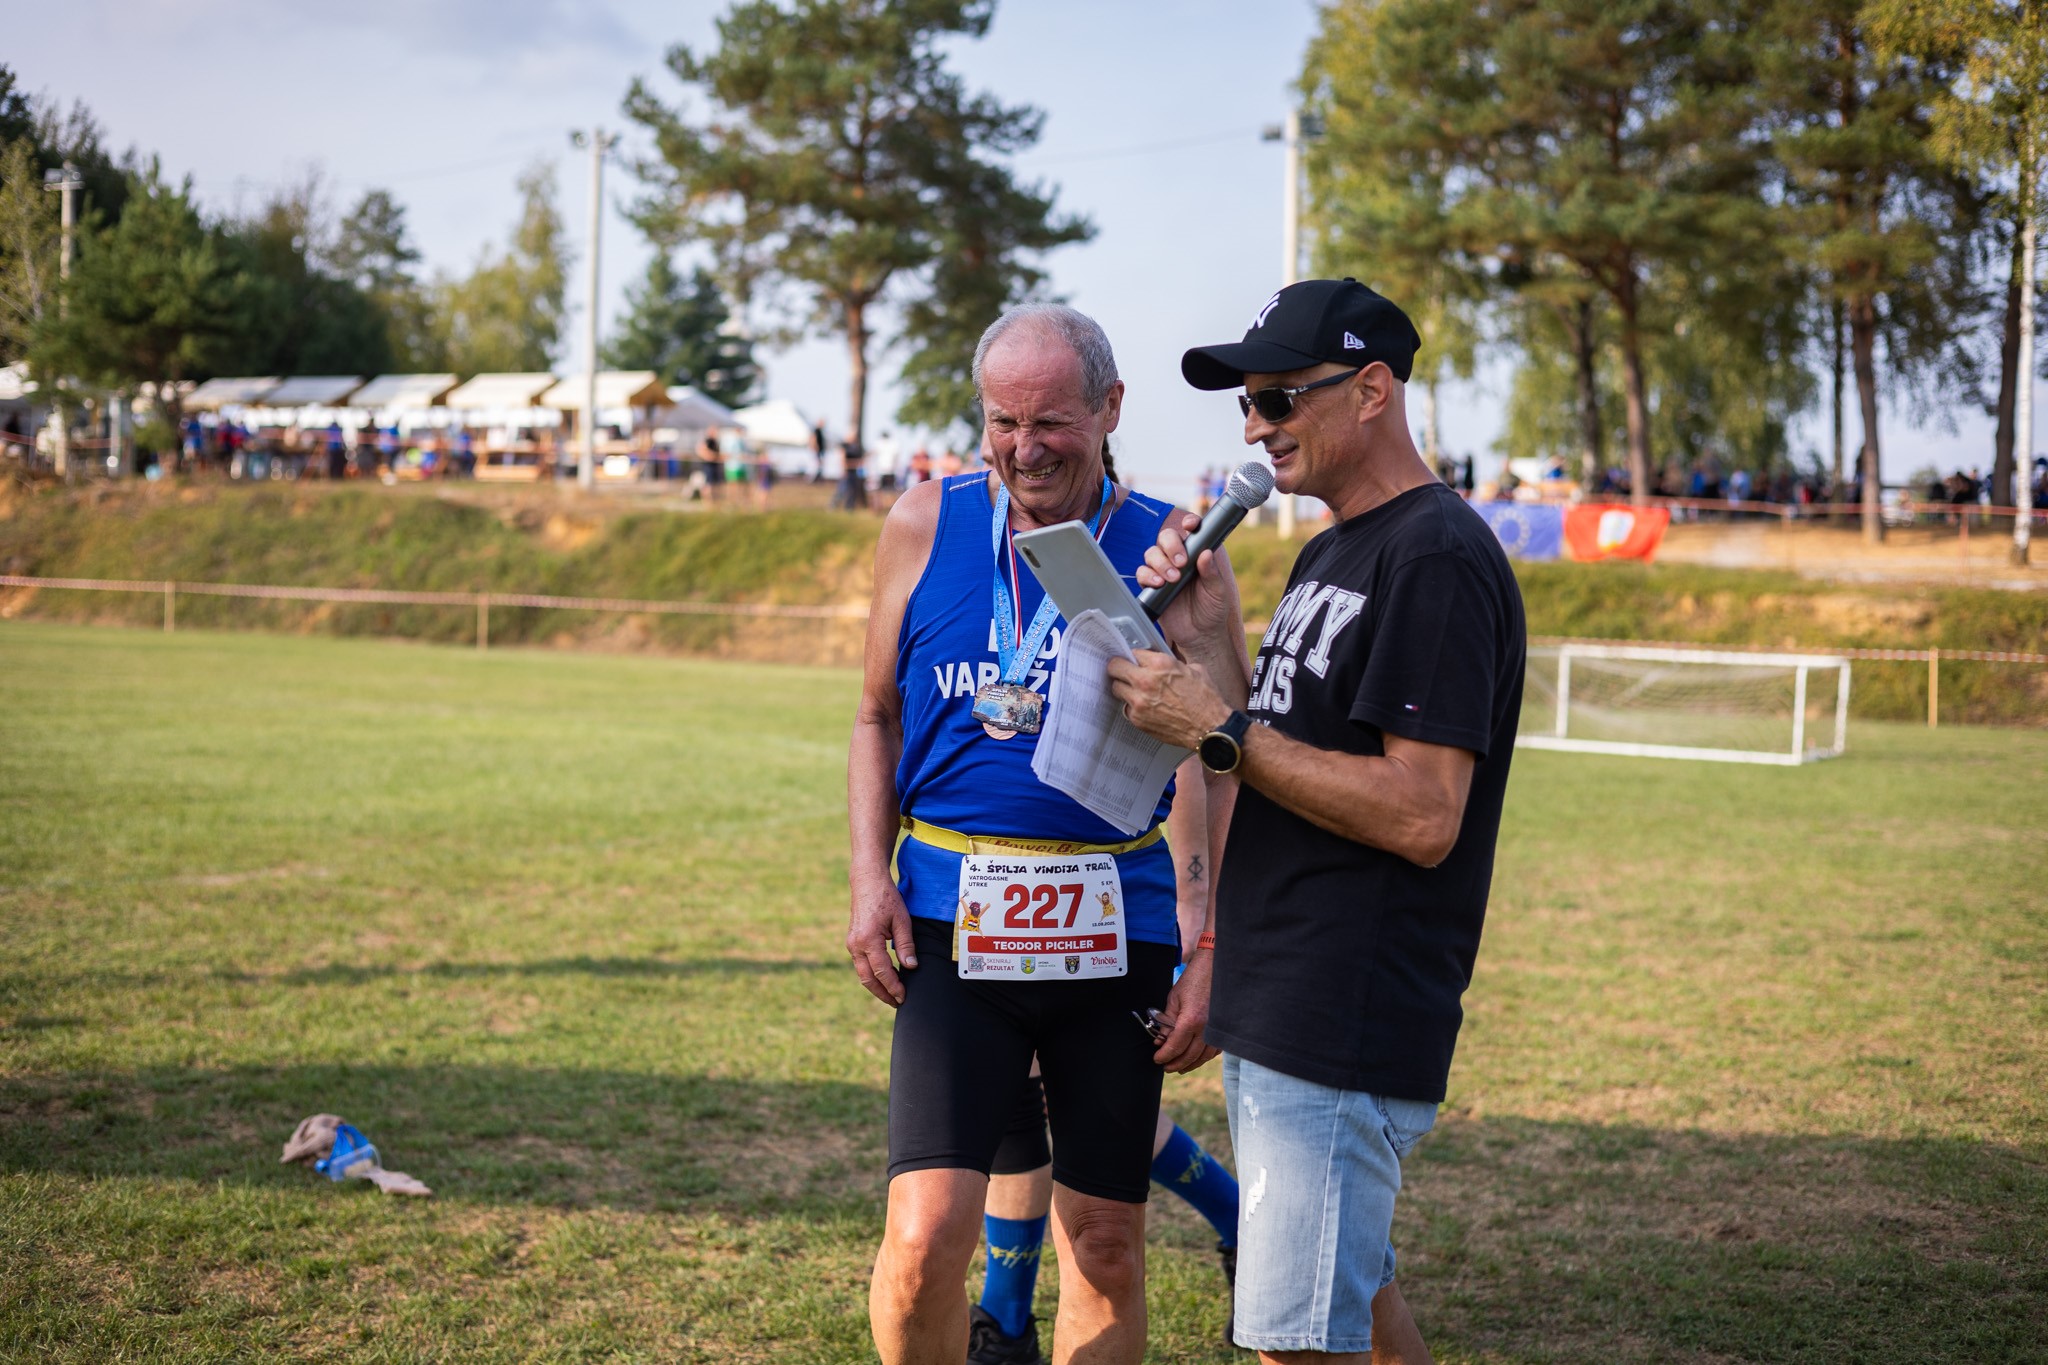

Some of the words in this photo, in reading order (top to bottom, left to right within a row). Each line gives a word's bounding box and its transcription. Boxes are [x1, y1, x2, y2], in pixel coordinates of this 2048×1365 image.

[969, 864, 981, 872] 4.
[1034, 864, 1080, 874] VINDIJA
[1085, 862, 1112, 872] TRAIL
[1003, 883, 1084, 929] 227
[993, 941, 1042, 951] TEODOR
[1045, 939, 1095, 951] PICHLER
